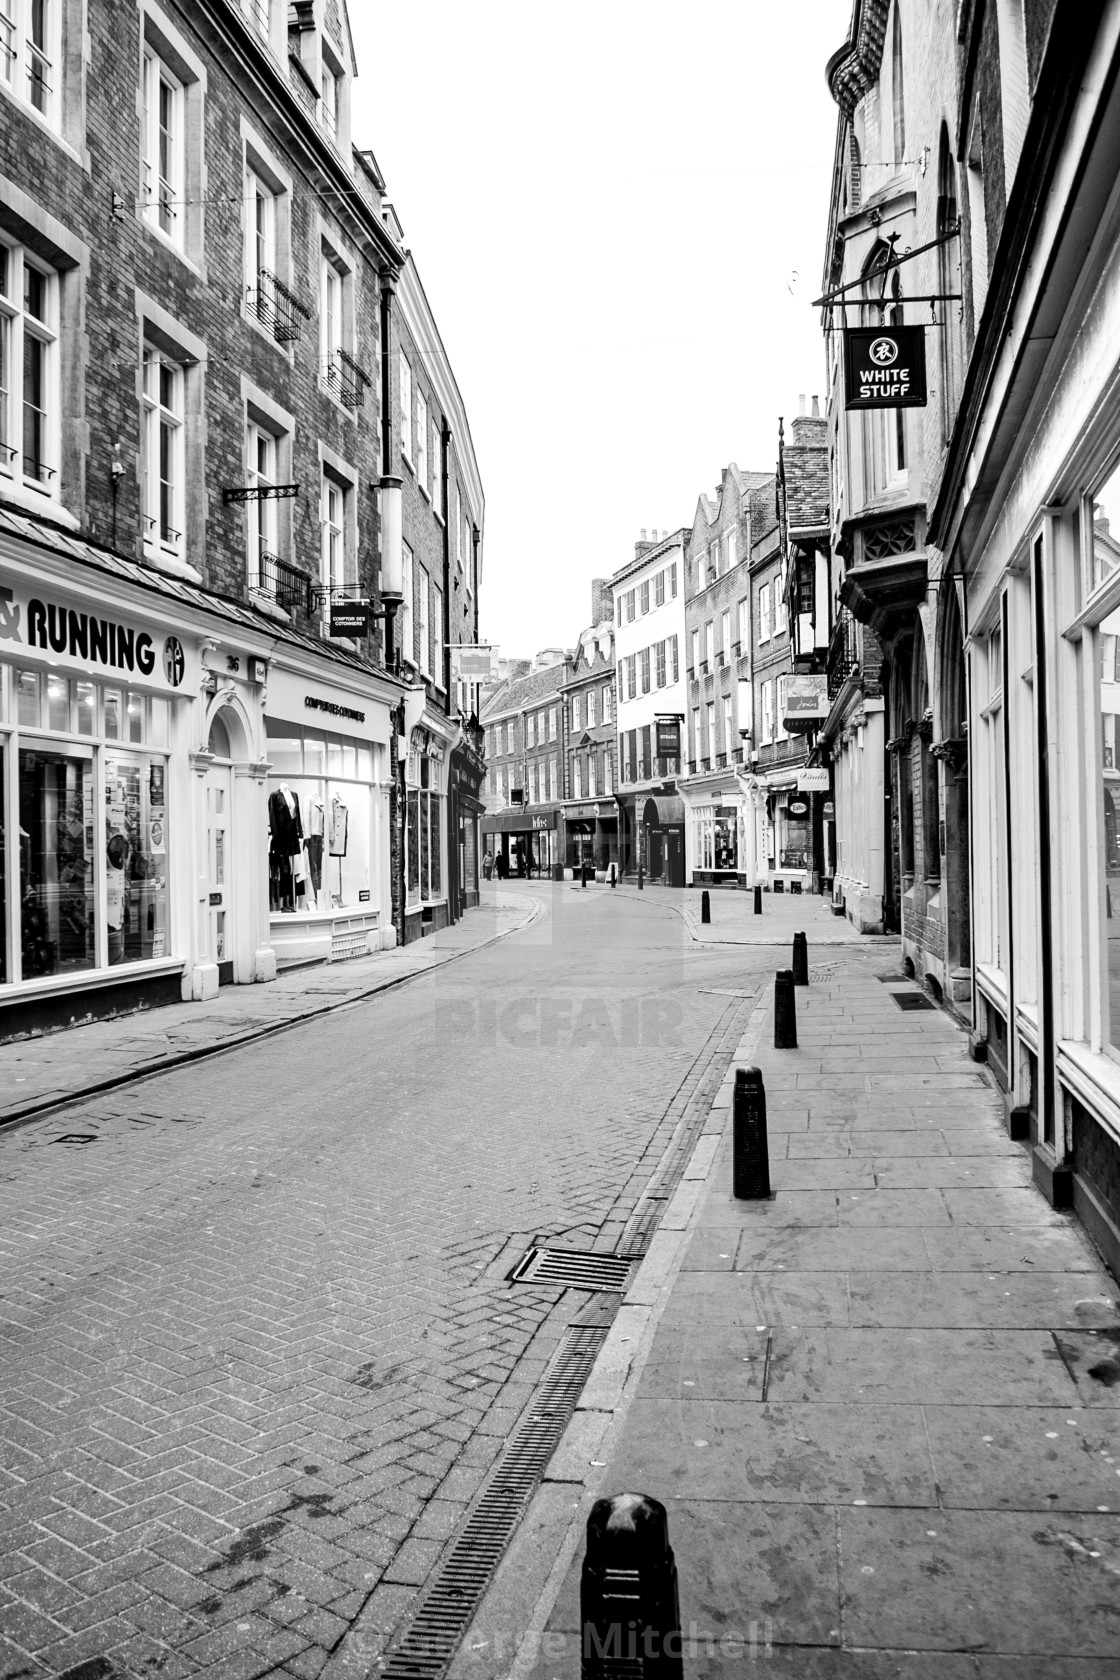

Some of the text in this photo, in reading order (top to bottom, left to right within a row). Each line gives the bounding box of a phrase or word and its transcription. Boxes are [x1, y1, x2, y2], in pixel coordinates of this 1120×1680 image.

[860, 368, 910, 383] WHITE
[860, 383, 910, 398] STUFF
[27, 598, 156, 676] RUNNING
